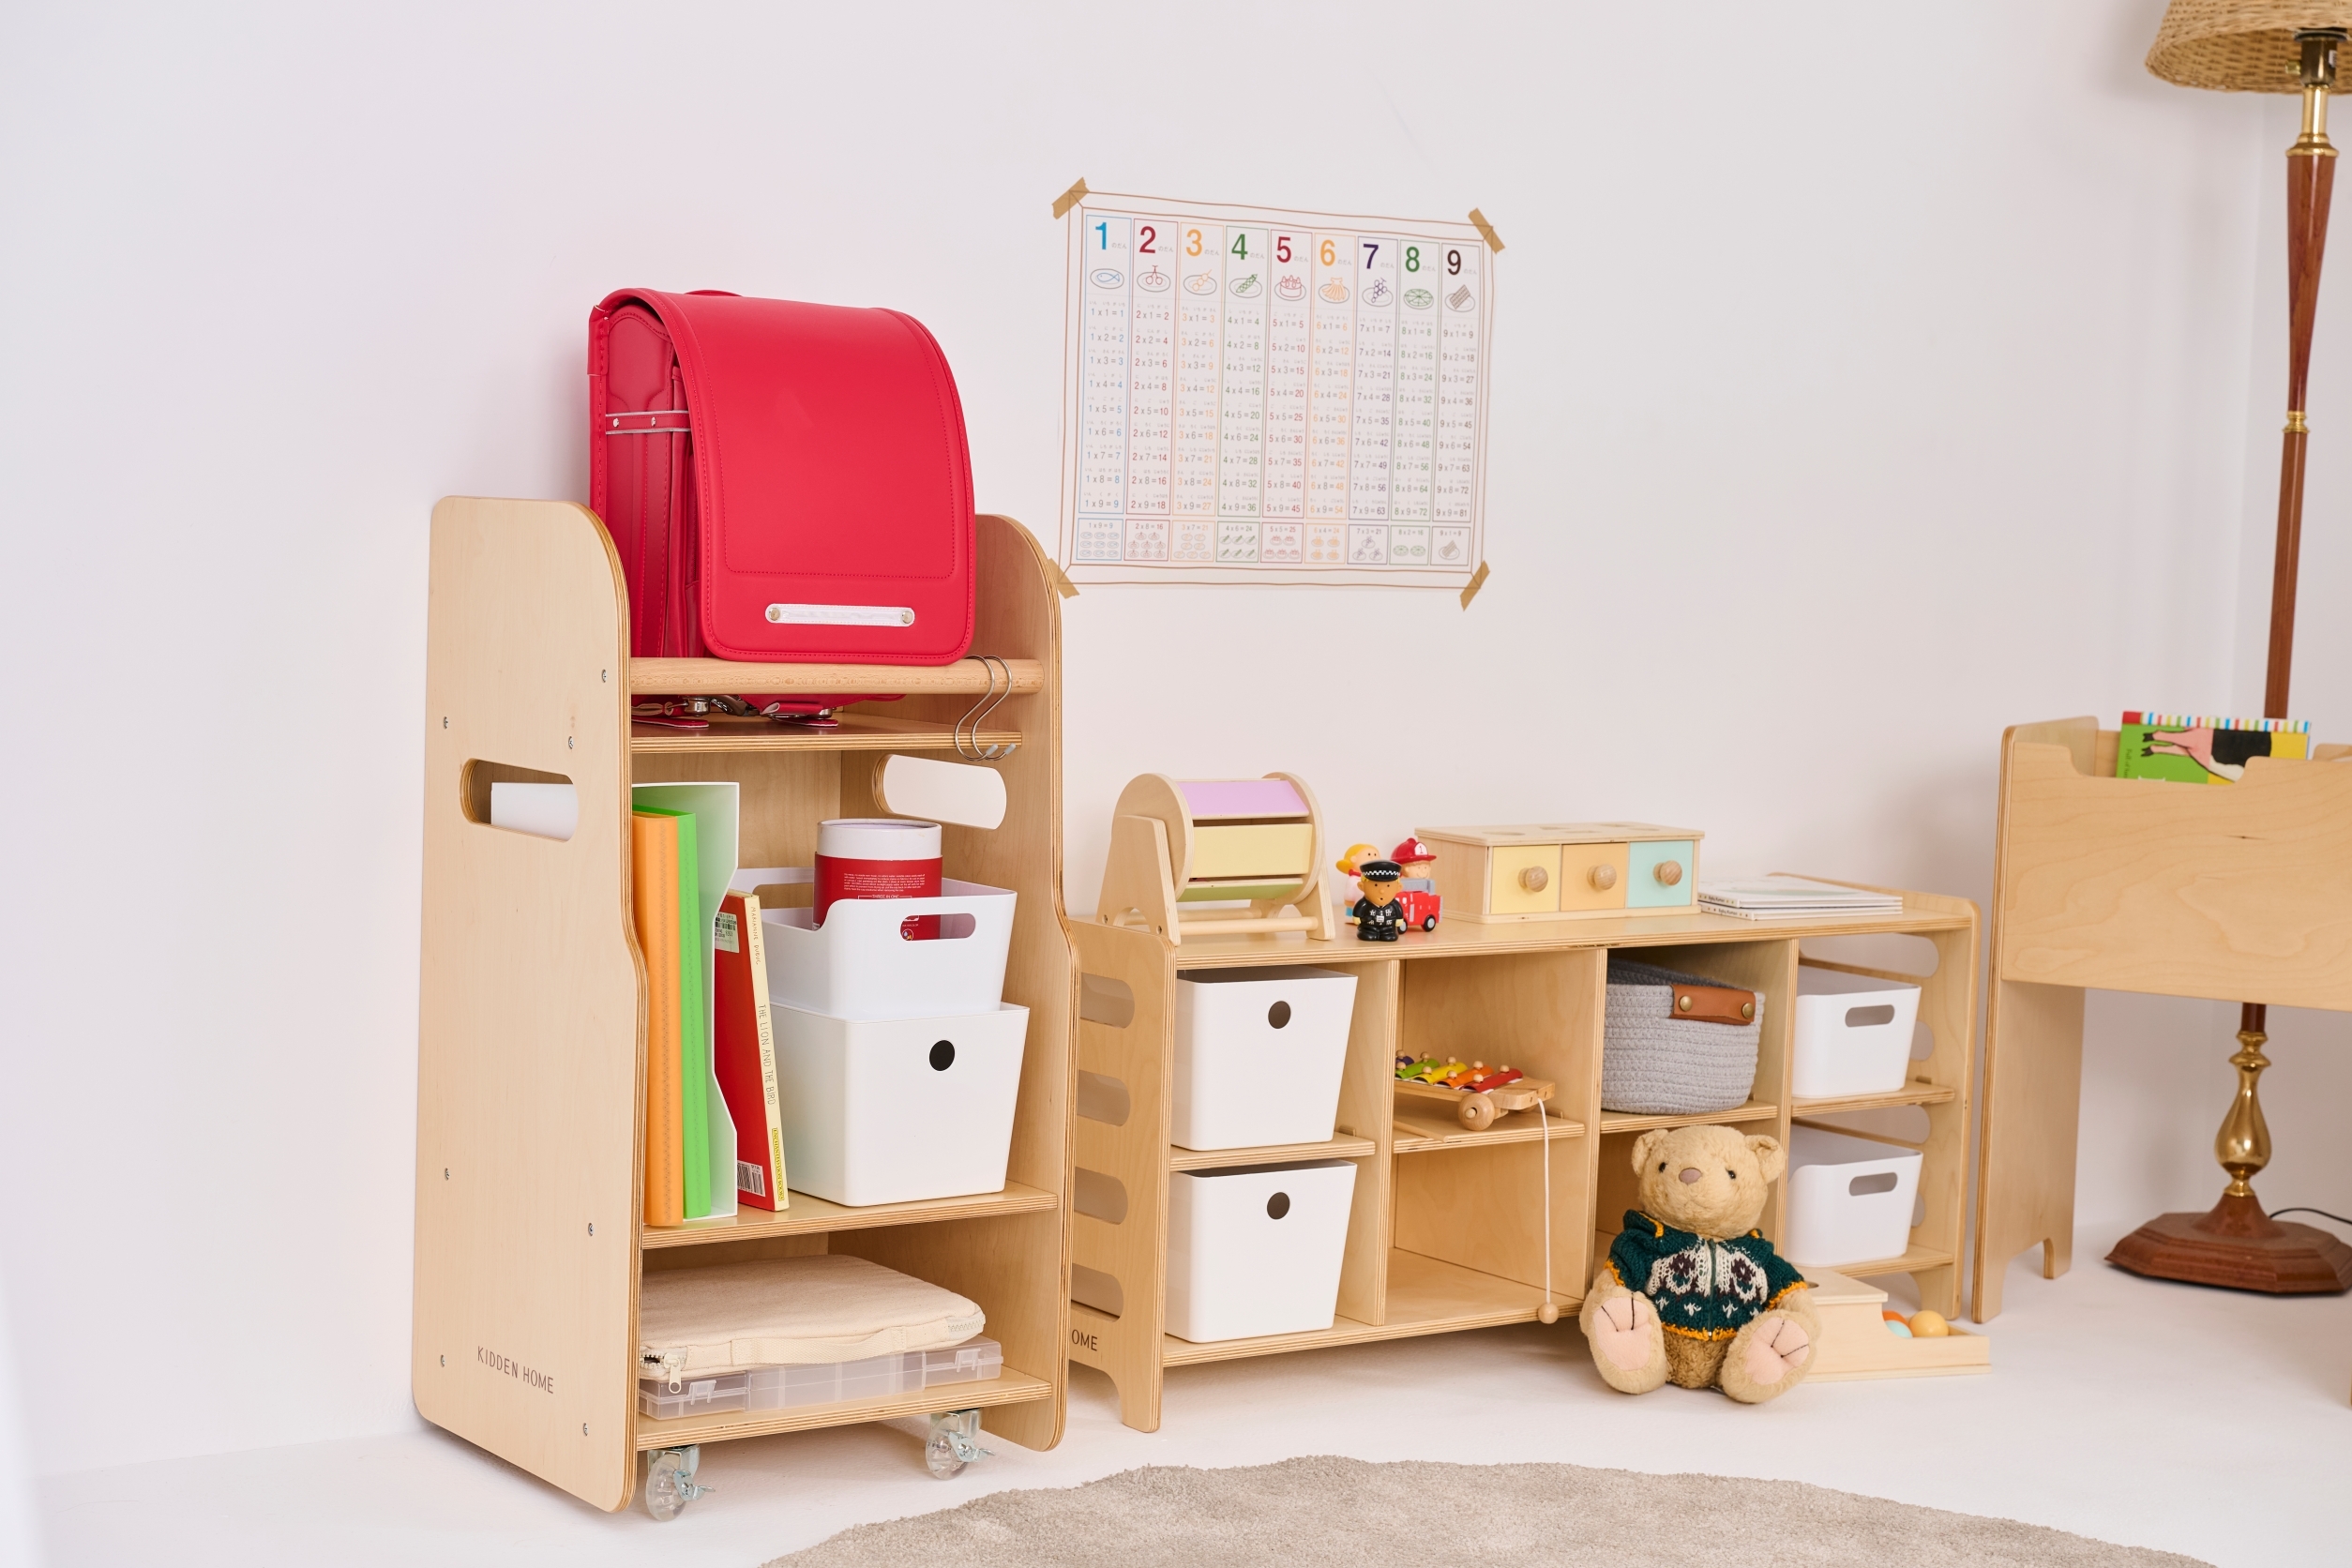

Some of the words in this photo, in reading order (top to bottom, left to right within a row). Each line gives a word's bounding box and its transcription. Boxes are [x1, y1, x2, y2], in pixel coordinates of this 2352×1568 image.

[1095, 221, 1108, 250] 1
[1139, 226, 1156, 254] 2
[1186, 229, 1203, 257] 3
[1231, 234, 1248, 261] 4
[1276, 236, 1291, 264] 5
[1319, 239, 1336, 266] 6
[1364, 243, 1380, 269] 7
[1405, 247, 1420, 273] 8
[1447, 249, 1462, 276] 9
[1419, 845, 1425, 854] 1
[759, 1003, 767, 1019] THE
[762, 1048, 772, 1067] AND
[764, 1069, 775, 1083] THE
[1071, 1329, 1098, 1351] OME
[477, 1345, 519, 1379] KIDDEN
[522, 1365, 554, 1395] HOME
